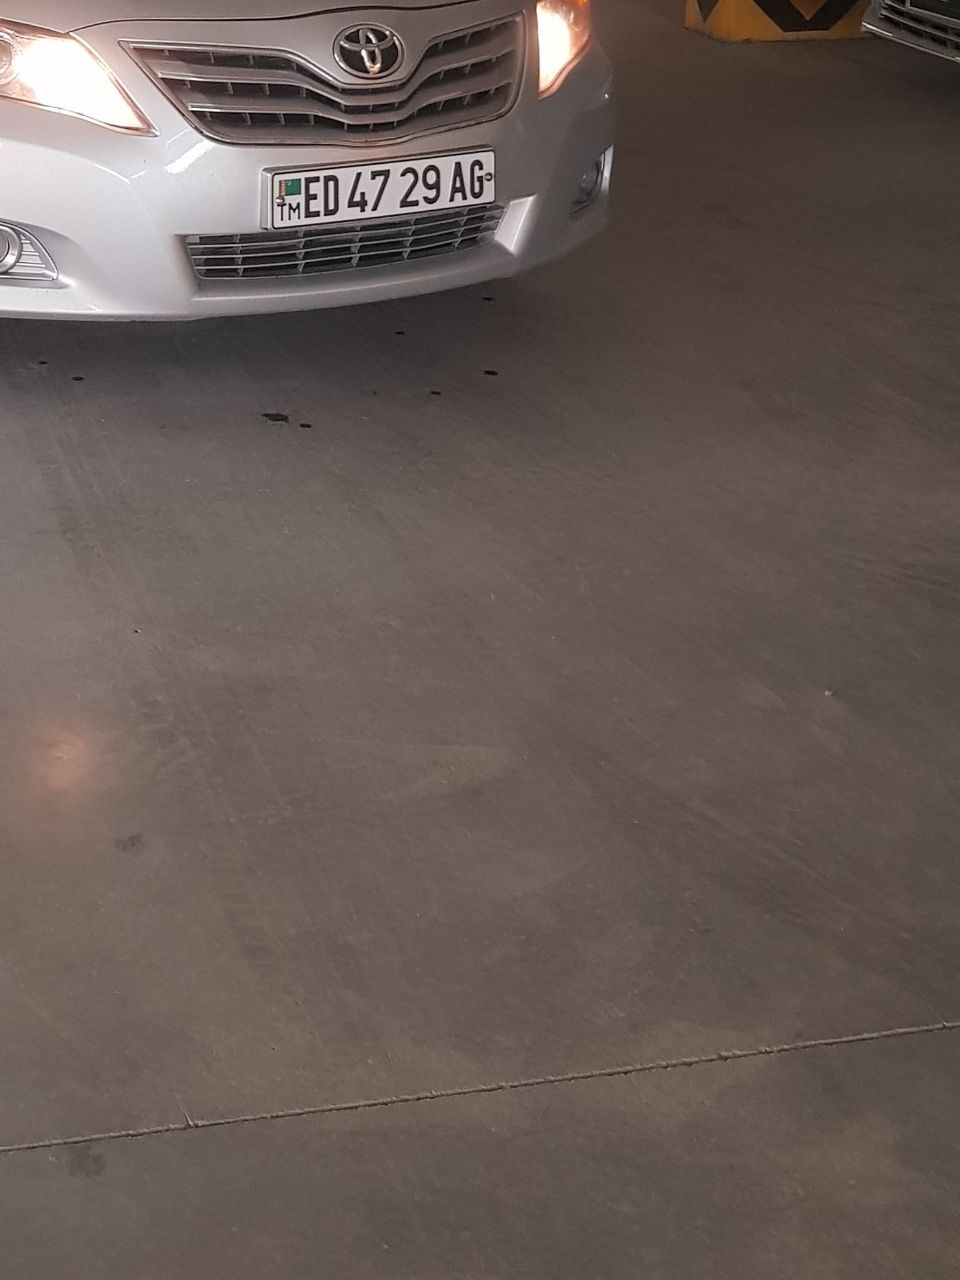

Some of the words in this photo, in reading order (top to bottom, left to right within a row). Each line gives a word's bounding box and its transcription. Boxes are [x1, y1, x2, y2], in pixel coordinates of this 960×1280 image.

[304, 175, 339, 218] ED
[347, 169, 390, 212] 47
[400, 164, 440, 208] 29
[449, 160, 484, 202] AG
[276, 202, 301, 221] TM
